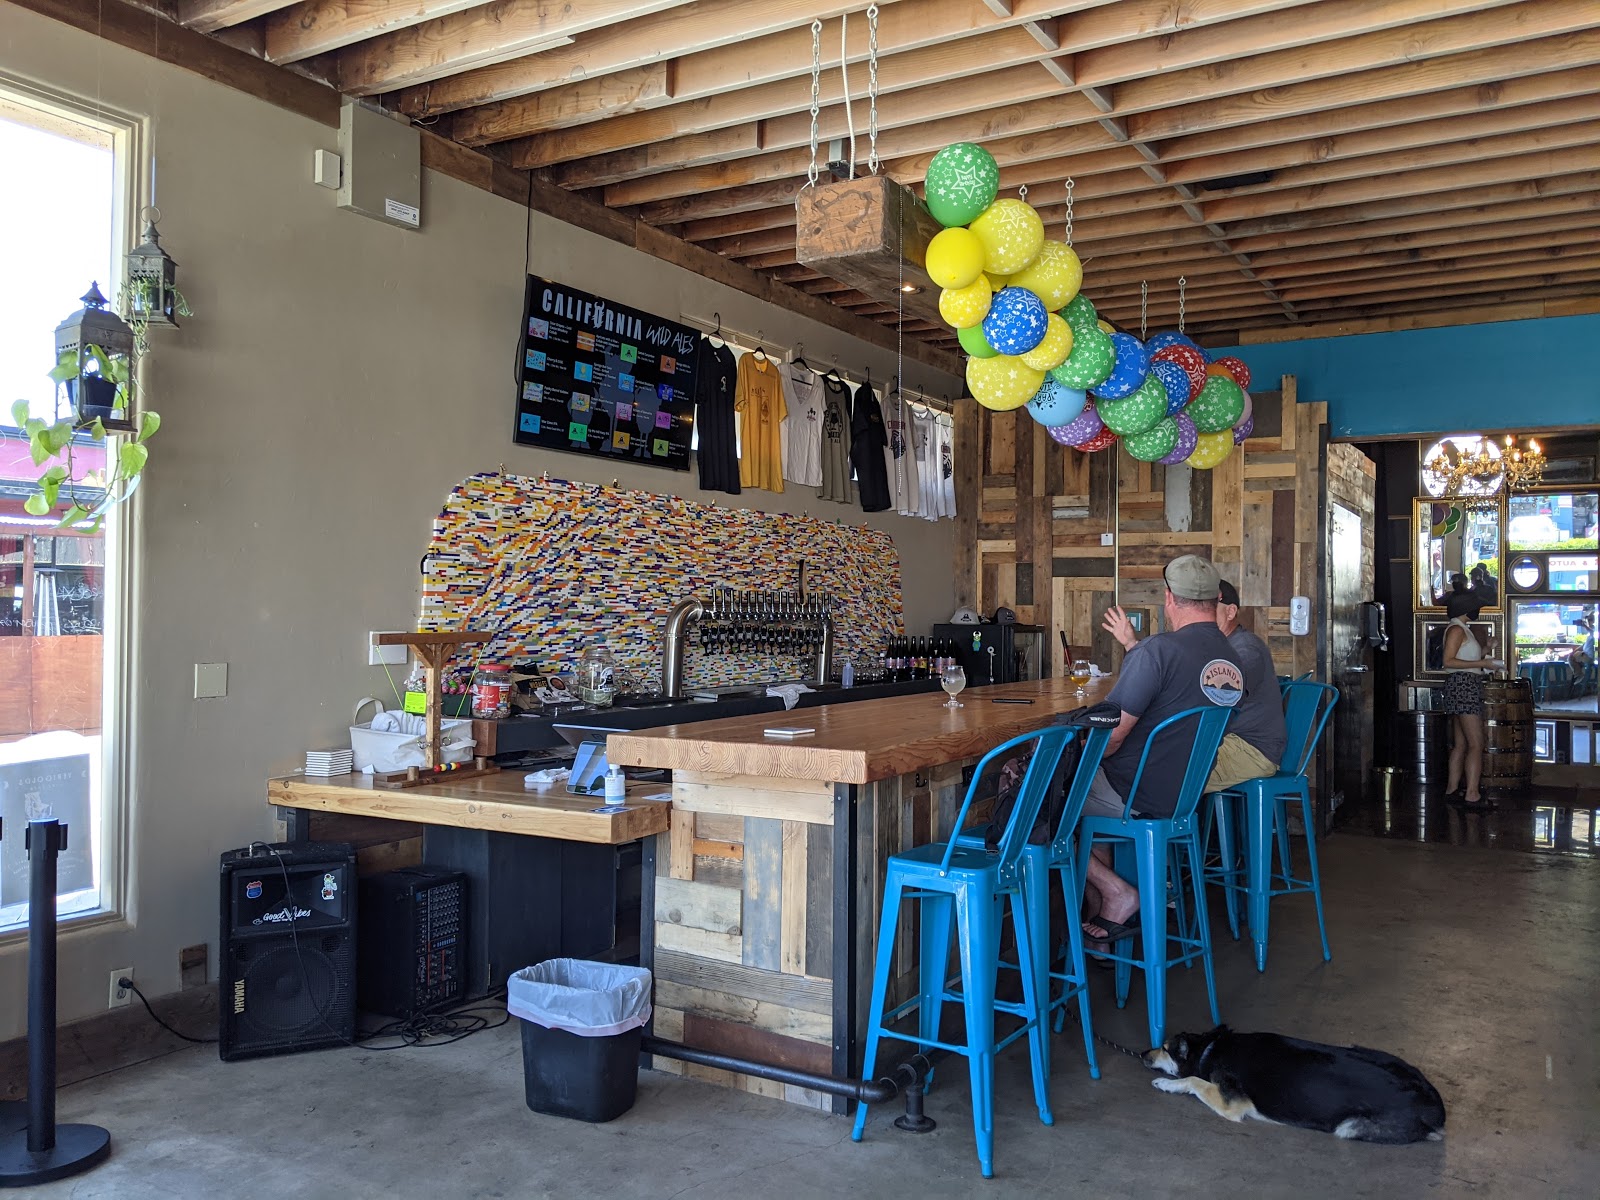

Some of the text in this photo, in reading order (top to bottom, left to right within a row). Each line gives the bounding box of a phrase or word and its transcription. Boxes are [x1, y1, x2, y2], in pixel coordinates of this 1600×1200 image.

[542, 288, 642, 341] CALIFORNIA
[645, 325, 671, 347] WILD
[671, 332, 694, 355] ALES
[1210, 667, 1236, 681] ISLAND
[234, 979, 245, 1014] YAMAHA
